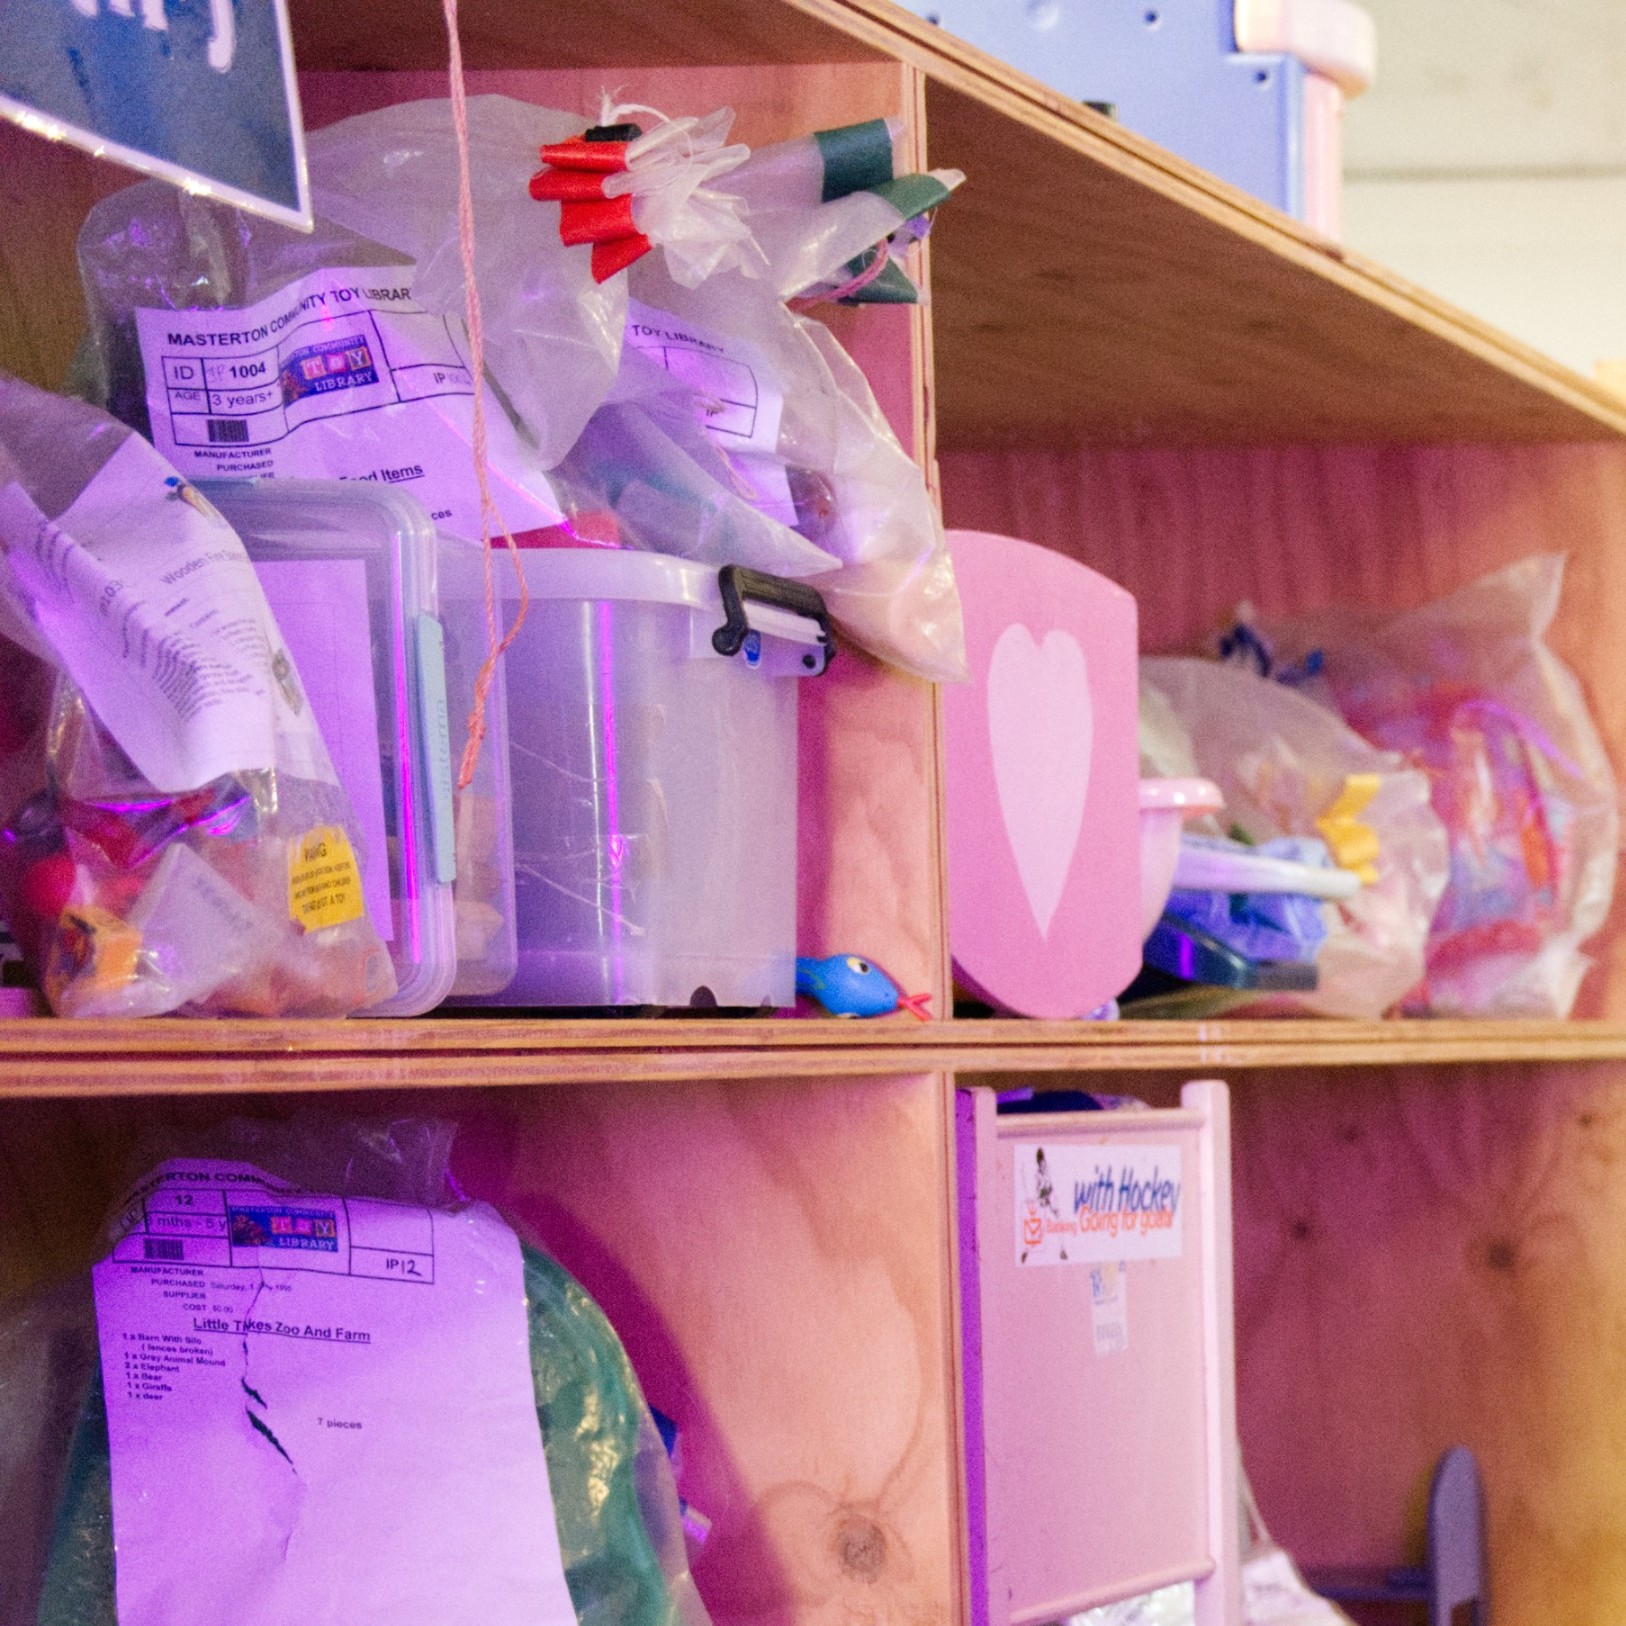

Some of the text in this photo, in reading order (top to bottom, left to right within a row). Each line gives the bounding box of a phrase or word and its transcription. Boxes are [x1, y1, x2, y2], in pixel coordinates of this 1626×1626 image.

[167, 288, 361, 347] MASTERTON TOY
[631, 325, 724, 353] TOY LIBRARY
[303, 347, 371, 380] TOY
[174, 362, 267, 380] ID 1004
[314, 371, 373, 393] LIBRARY
[433, 373, 446, 385] IP
[174, 389, 274, 409] AGE 3 years+
[194, 448, 272, 460] MANUFACTURER
[216, 459, 274, 472] PURCHASED
[380, 464, 424, 482] Items
[1073, 1164, 1181, 1215] with Hockey
[174, 1193, 194, 1206] 12
[1079, 1204, 1119, 1238] Going
[278, 1236, 335, 1251] LIBRARY
[130, 1265, 205, 1277] MANUFACTURER
[150, 1278, 206, 1289] PURCHASED
[162, 1290, 207, 1300] SUPPLIER
[182, 1303, 207, 1312] COST
[193, 1316, 372, 1343] Little Zoo And Farm
[161, 1334, 183, 1344] With
[163, 1354, 194, 1365] Animal
[196, 1357, 226, 1367] Mound
[140, 1362, 181, 1374] Elephant
[140, 1373, 163, 1382] Bear
[326, 1420, 363, 1431] pieces
